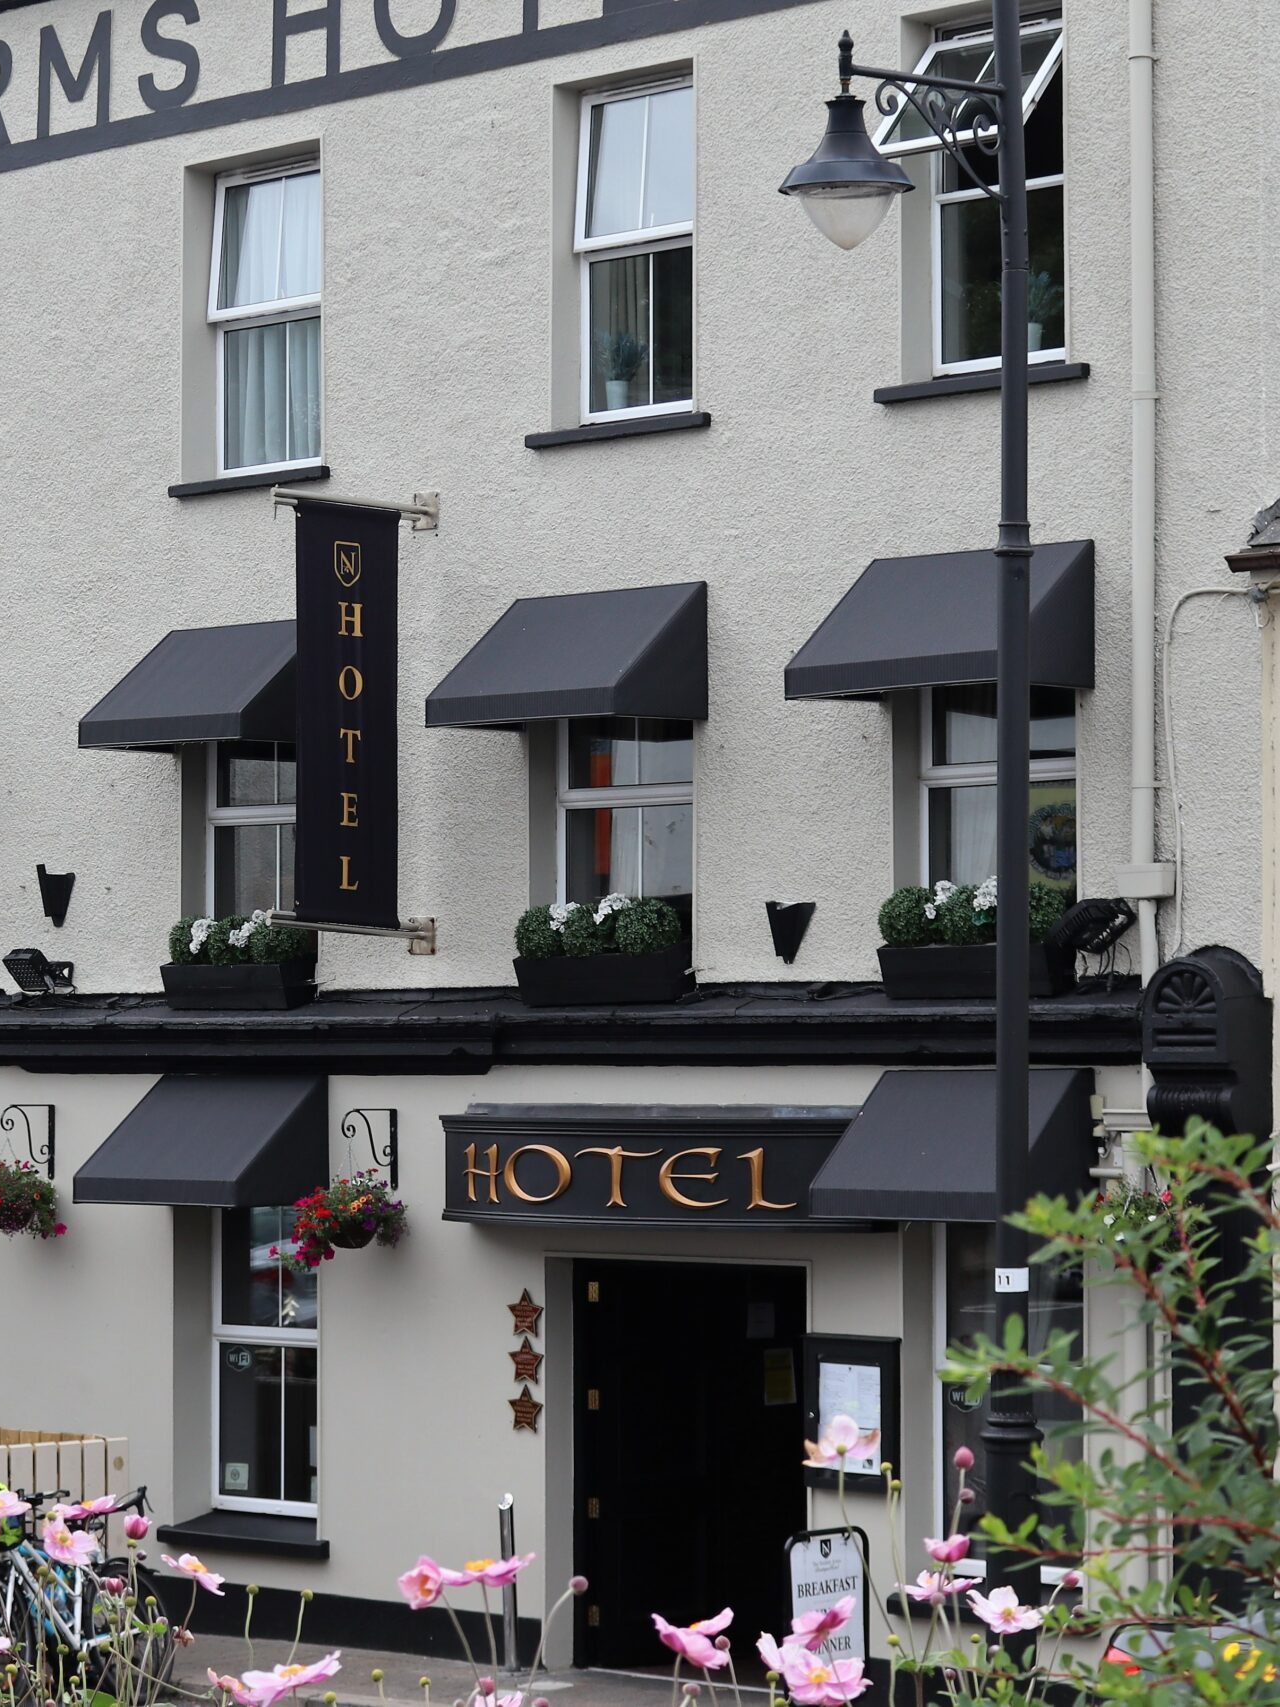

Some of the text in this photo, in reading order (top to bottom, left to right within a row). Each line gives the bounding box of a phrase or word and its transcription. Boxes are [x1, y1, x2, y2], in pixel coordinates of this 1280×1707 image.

[337, 601, 364, 891] HOTEL
[463, 1143, 797, 1210] HOTEL
[797, 1576, 857, 1599] BREAKFAST
